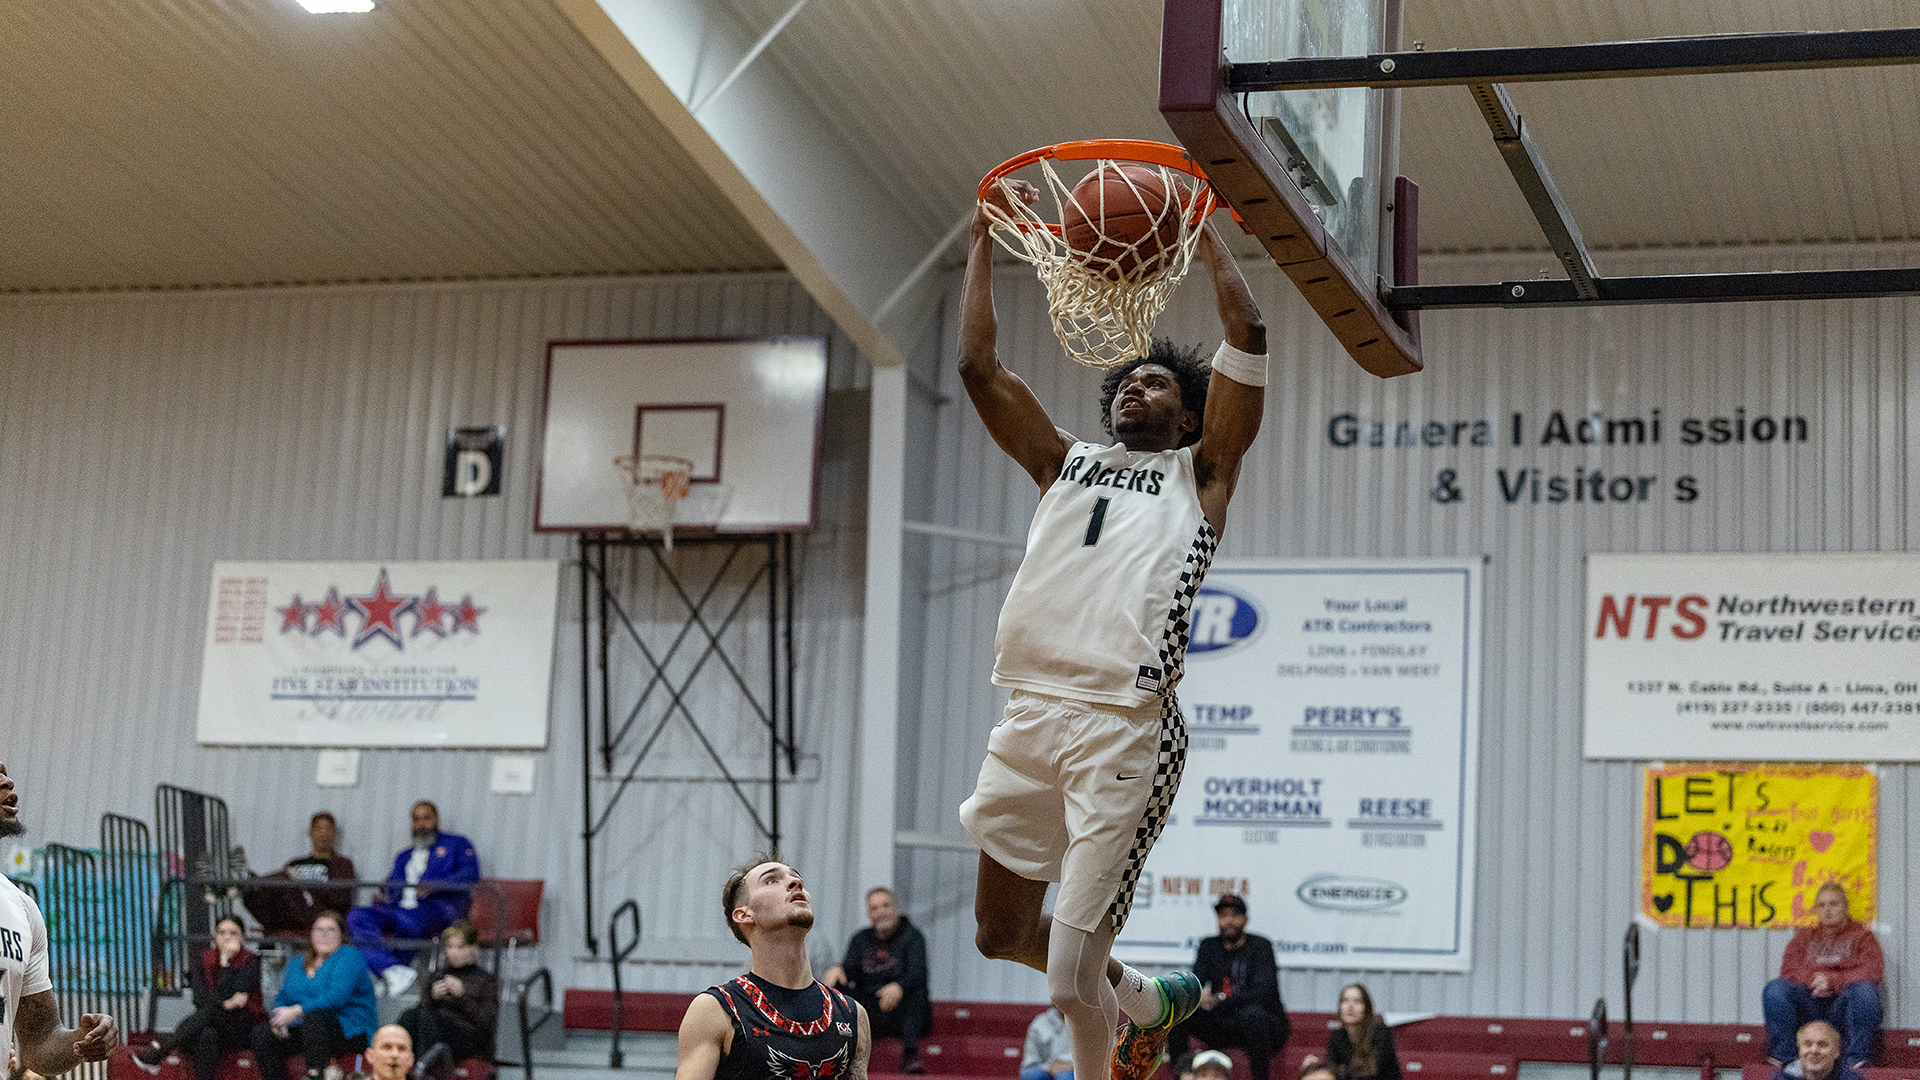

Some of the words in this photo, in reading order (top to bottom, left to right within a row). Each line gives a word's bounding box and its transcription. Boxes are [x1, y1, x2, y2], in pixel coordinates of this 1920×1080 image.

[1060, 456, 1164, 495] RACERS
[1430, 468, 1463, 503] &
[1082, 496, 1112, 547] 1
[1323, 600, 1360, 613] Your
[1364, 599, 1407, 613] Local
[1595, 594, 1708, 640] NTS
[1717, 595, 1915, 617] Northwestern
[1302, 619, 1334, 632] ATR
[1338, 619, 1432, 633] Contractors
[1718, 623, 1803, 641] Travel
[1360, 645, 1428, 657] FINDLAY
[1147, 668, 1153, 677] L
[1817, 681, 1828, 693] A
[1194, 705, 1252, 721] TEMP
[1304, 707, 1402, 724] PERRY'S
[1204, 778, 1322, 795] OVERHOLT
[1204, 799, 1320, 816] MOORMAN
[1359, 799, 1431, 816] REESE
[1162, 877, 1201, 895] NEW
[1310, 886, 1396, 899] ENERGIZE
